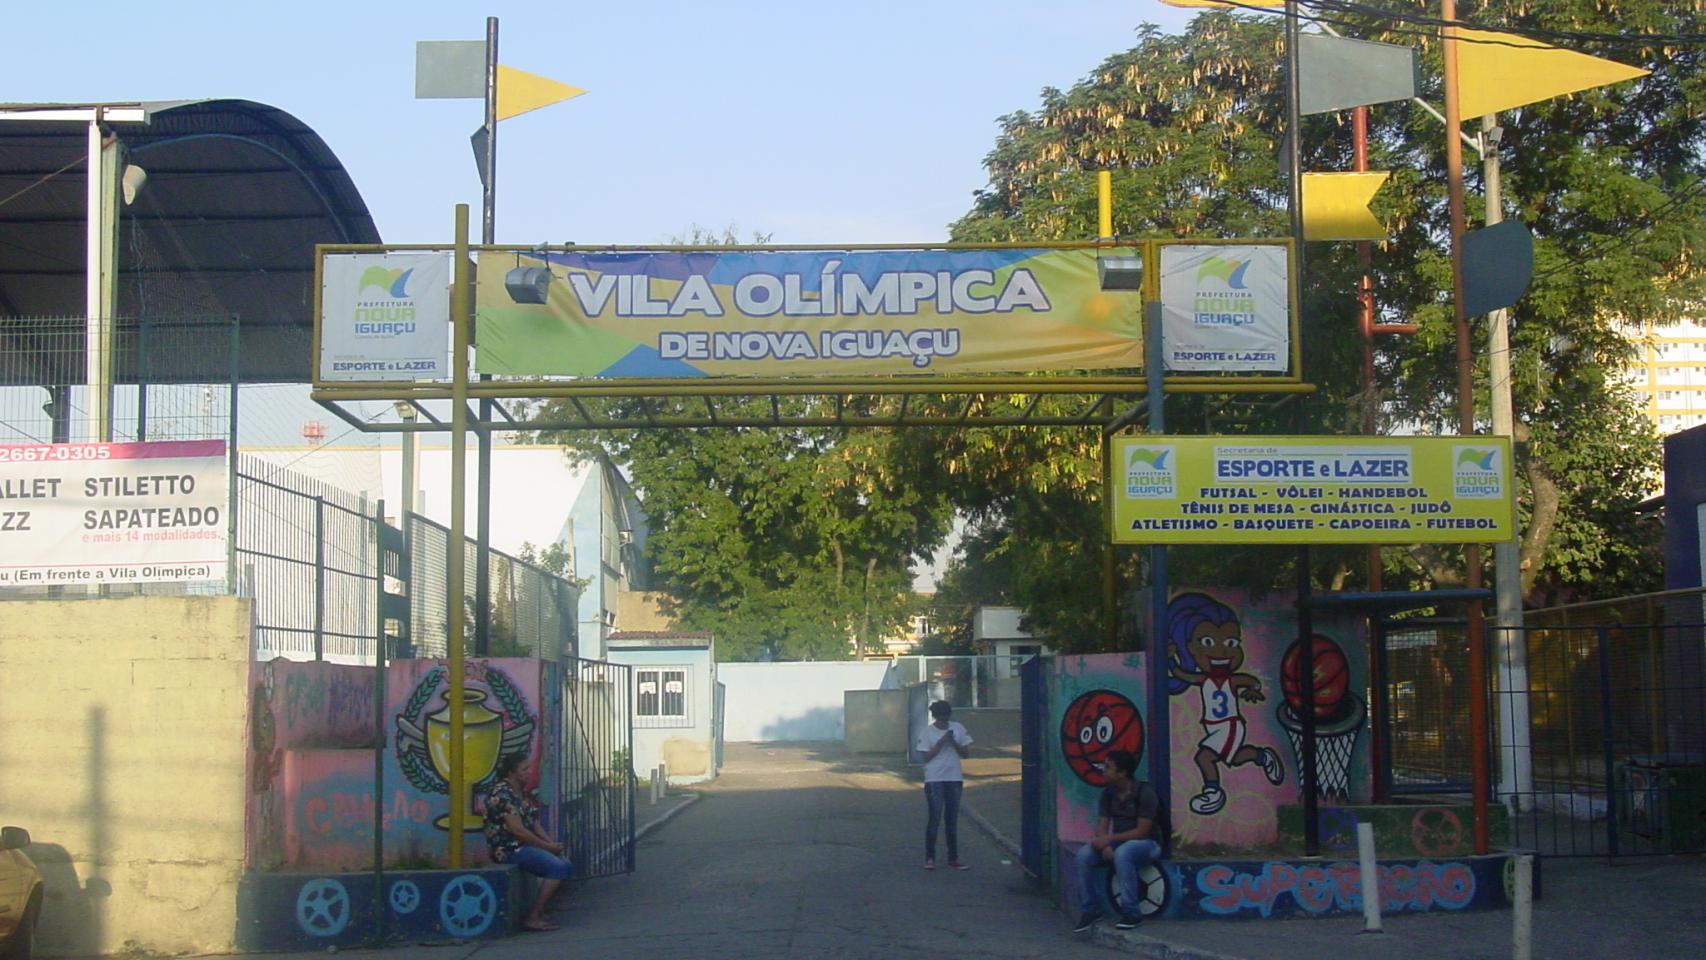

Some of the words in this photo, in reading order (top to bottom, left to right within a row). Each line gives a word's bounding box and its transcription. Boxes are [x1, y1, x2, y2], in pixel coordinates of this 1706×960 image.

[569, 272, 724, 317] VILA
[735, 259, 1051, 317] OLÍMPICA
[1194, 313, 1254, 326] IGUAÇU
[355, 323, 416, 335] IGUAÇU
[660, 331, 709, 360] DE
[712, 331, 817, 360] NOVA
[820, 328, 959, 368] IGUAÇU
[1173, 352, 1225, 361] ESPORTE
[1236, 352, 1276, 361] LAZER
[333, 361, 385, 371] ESPORTE
[396, 361, 436, 370] LAZER
[0, 446, 110, 461] 2667-0305
[1218, 459, 1315, 477] ESPORTE
[1319, 464, 1330, 477] e
[1334, 459, 1409, 477] LAZER
[84, 474, 195, 498] STILETTO
[1128, 486, 1173, 495] IGUAÇU
[1200, 487, 1257, 498] FUTSAL
[1276, 485, 1323, 498] VÔLEI
[1338, 487, 1428, 498] HANDEBOL
[1456, 486, 1499, 495] IGUAÇU
[1181, 501, 1224, 514] TÊNIS
[1228, 504, 1249, 514] DE
[1253, 504, 1295, 514] MESA
[1310, 500, 1395, 514] GINÁSTICA
[1411, 500, 1452, 515] JUDÔ
[84, 506, 219, 530] SAPATEADO
[1131, 519, 1218, 530] ATLETISMO
[1233, 519, 1314, 531] BASQUETE
[1329, 519, 1411, 529] CAPOEIRA
[1427, 518, 1497, 529] FUTEBOL
[82, 535, 89, 543] e
[93, 531, 120, 542] mais
[127, 531, 139, 542] 14
[14, 570, 42, 583] (Em
[47, 568, 91, 581] frente
[109, 567, 137, 579] Vila
[1212, 690, 1229, 719] 3
